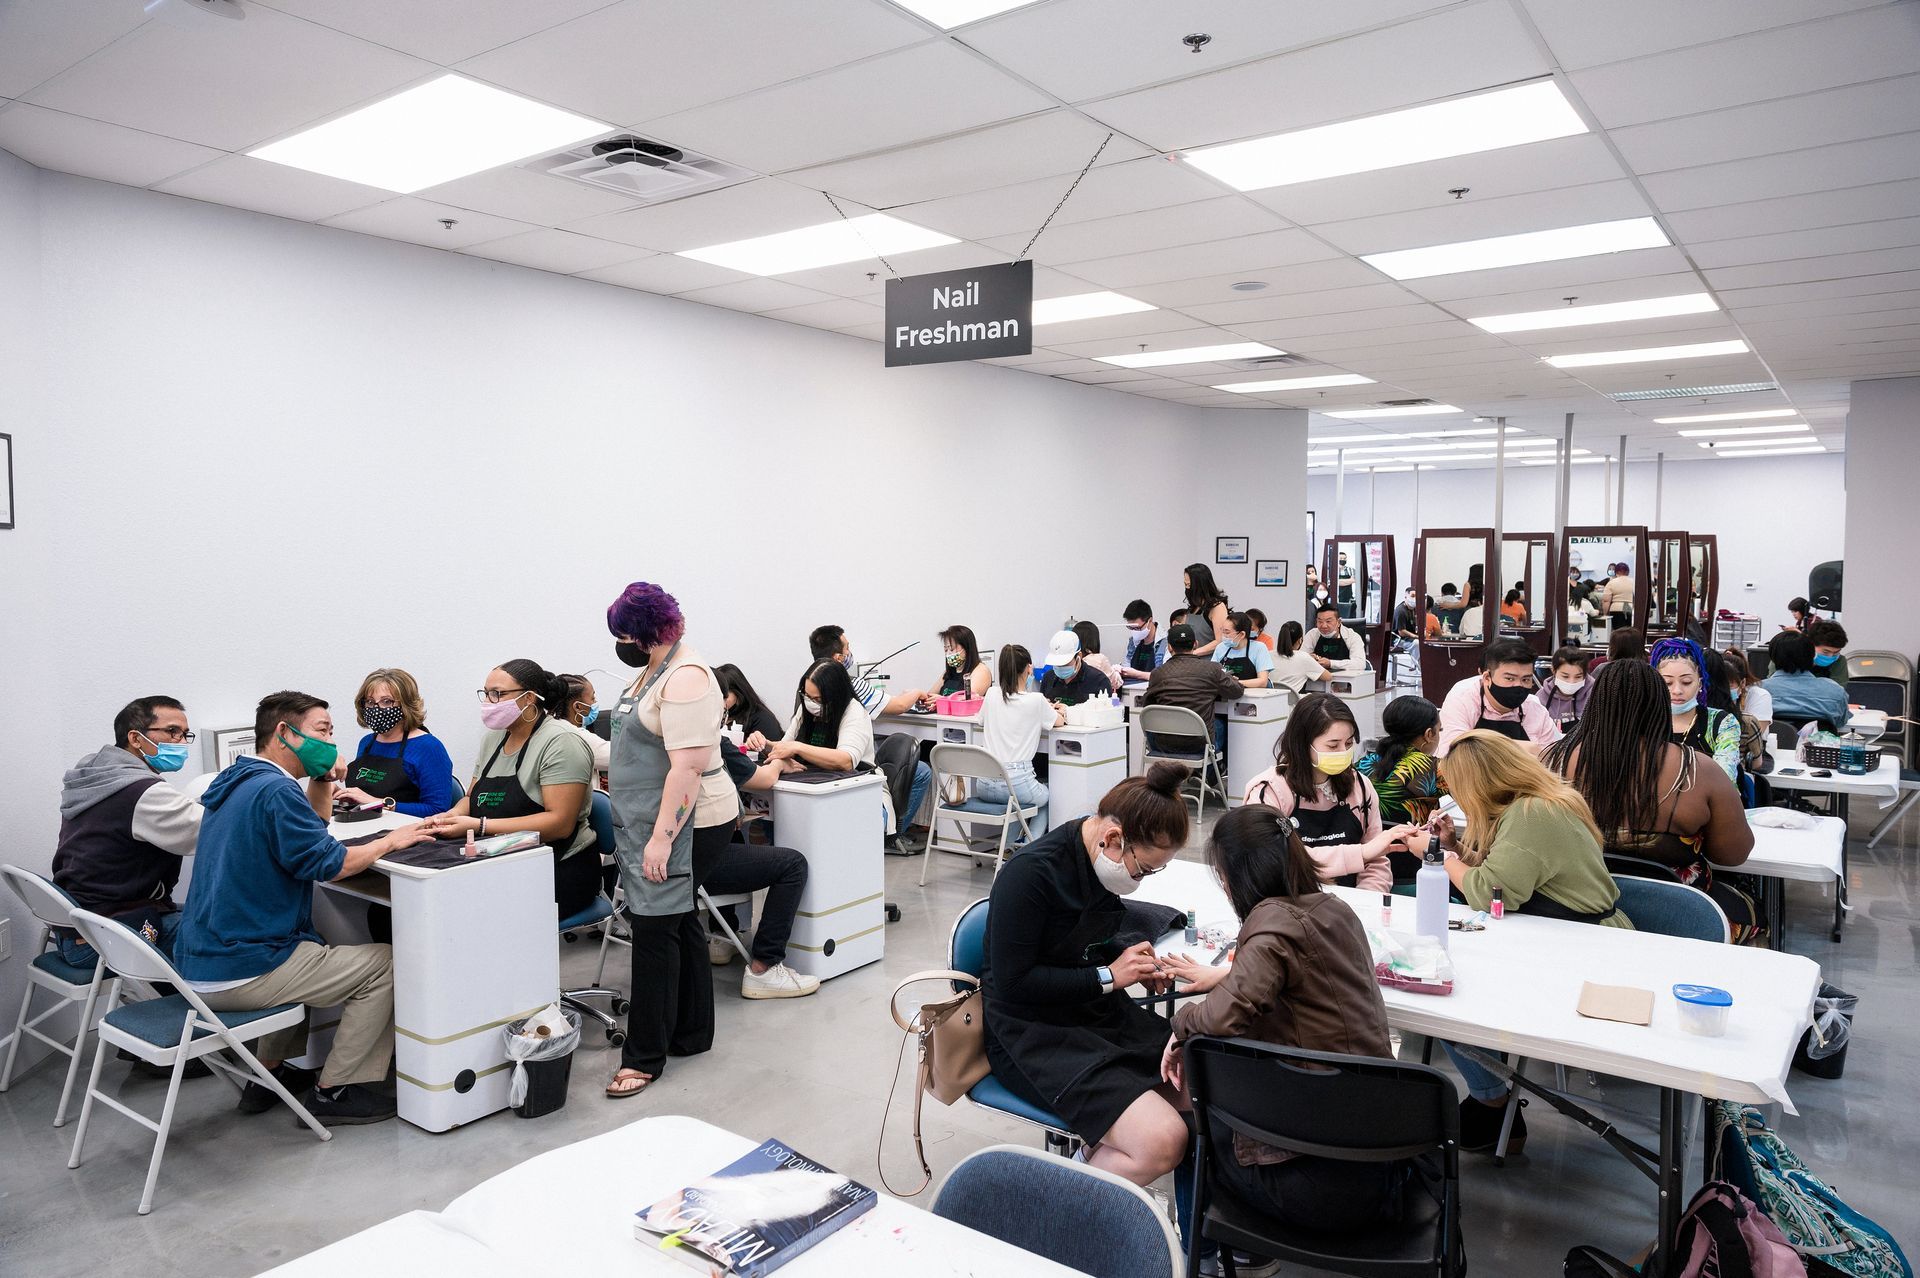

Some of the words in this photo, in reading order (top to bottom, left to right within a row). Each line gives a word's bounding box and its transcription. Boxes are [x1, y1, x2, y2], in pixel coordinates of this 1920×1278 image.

[933, 281, 979, 310] Nail
[895, 318, 1019, 348] Freshman
[1301, 831, 1346, 843] derlogica
[760, 1143, 829, 1175] HNOLOGY
